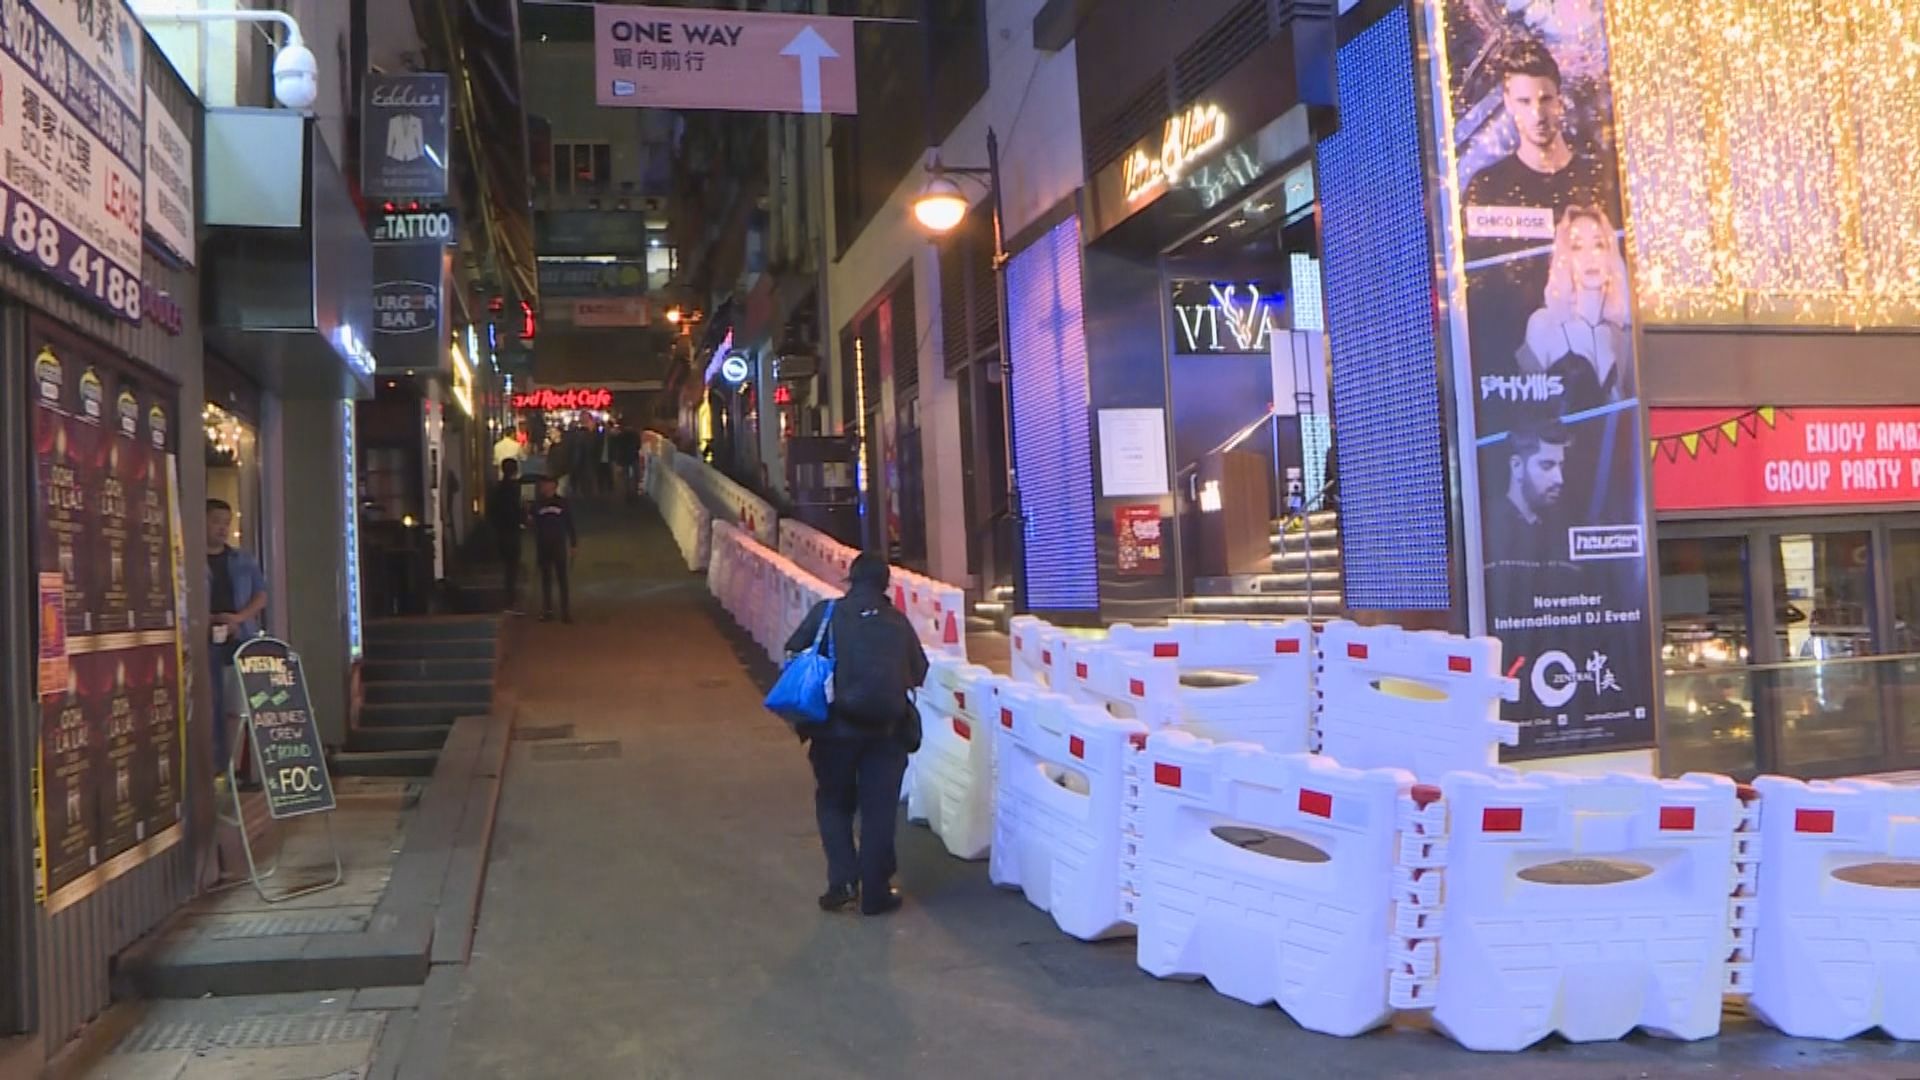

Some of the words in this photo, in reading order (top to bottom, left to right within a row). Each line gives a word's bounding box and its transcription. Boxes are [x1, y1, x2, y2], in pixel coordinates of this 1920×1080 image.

[611, 20, 673, 44] ONE
[681, 24, 744, 47] WAY
[612, 48, 706, 72] 單向前行
[371, 82, 441, 107] Eddie's
[104, 165, 140, 237] LEASE
[384, 213, 451, 239] TATTOO
[1476, 215, 1514, 227] CHICO
[1515, 217, 1546, 228] ROSE
[68, 243, 140, 320] 4188
[373, 294, 437, 311] URGER
[381, 311, 417, 327] BAR
[1175, 283, 1272, 351] VIVA
[514, 389, 541, 407] ard
[541, 388, 577, 408] Rock
[577, 388, 613, 408] Cafe
[1805, 422, 1866, 453] ENJOY
[1876, 421, 1920, 452] AMA
[1764, 460, 1831, 493] GROUP
[1841, 457, 1902, 490] PARTY
[1534, 594, 1602, 609] November
[1495, 613, 1582, 630] International
[1585, 612, 1601, 625] DJ
[1605, 609, 1641, 623] Event
[1552, 672, 1594, 684] ZENTRAL
[1586, 650, 1622, 696] 中央
[254, 710, 307, 729] AIRLINES
[269, 727, 303, 741] CREW
[279, 765, 324, 793] FOC
